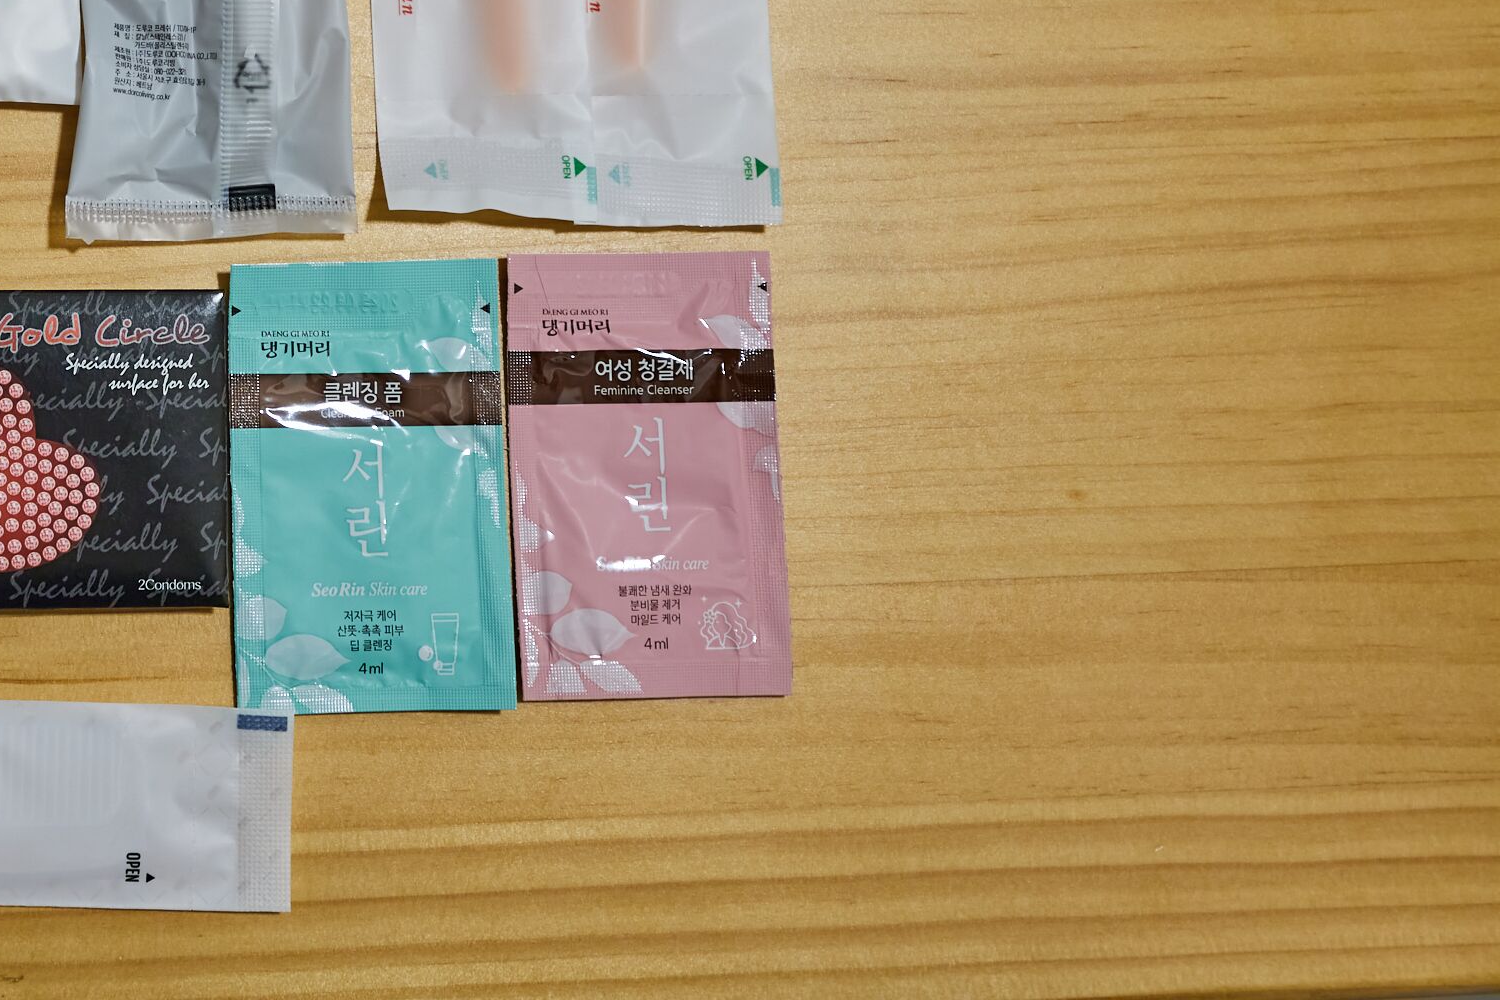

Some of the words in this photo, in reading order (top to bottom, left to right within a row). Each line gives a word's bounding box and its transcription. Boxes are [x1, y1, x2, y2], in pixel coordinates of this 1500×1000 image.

[561, 155, 571, 179] OPEN
[743, 156, 753, 181] OPEN
[95, 313, 209, 348] Circle
[261, 330, 289, 338] DAENG
[542, 319, 611, 336] 댕기머리
[261, 340, 331, 358] 댕기머리
[66, 353, 132, 377] Specially
[134, 353, 193, 375] designed
[595, 358, 632, 382] 여성
[637, 358, 694, 382] 청결제
[108, 373, 158, 396] surface
[161, 373, 186, 396] for
[188, 376, 210, 390] her
[594, 385, 644, 395] Feminine
[647, 385, 694, 395] Cleanser
[323, 381, 378, 404] 클렌징
[384, 381, 403, 404] 폼
[138, 579, 202, 591] 2Condoms
[311, 582, 338, 597] Seo
[339, 582, 366, 597] Rin
[369, 581, 397, 597] Skin
[400, 584, 428, 596] care
[618, 585, 648, 597] 불쾌한
[650, 585, 670, 597] 냄새
[673, 584, 692, 596] 완화
[630, 600, 659, 612] 분비물
[662, 599, 681, 611] 제거
[344, 610, 373, 623] 저자극
[377, 609, 397, 622] 케어
[630, 614, 659, 626] 마일드
[662, 613, 681, 625] 케어
[384, 624, 404, 637] 피부
[363, 639, 393, 651] 클렌징
[644, 638, 669, 650] 4ml
[358, 662, 384, 675] 4ml
[124, 852, 141, 883] OPEN
